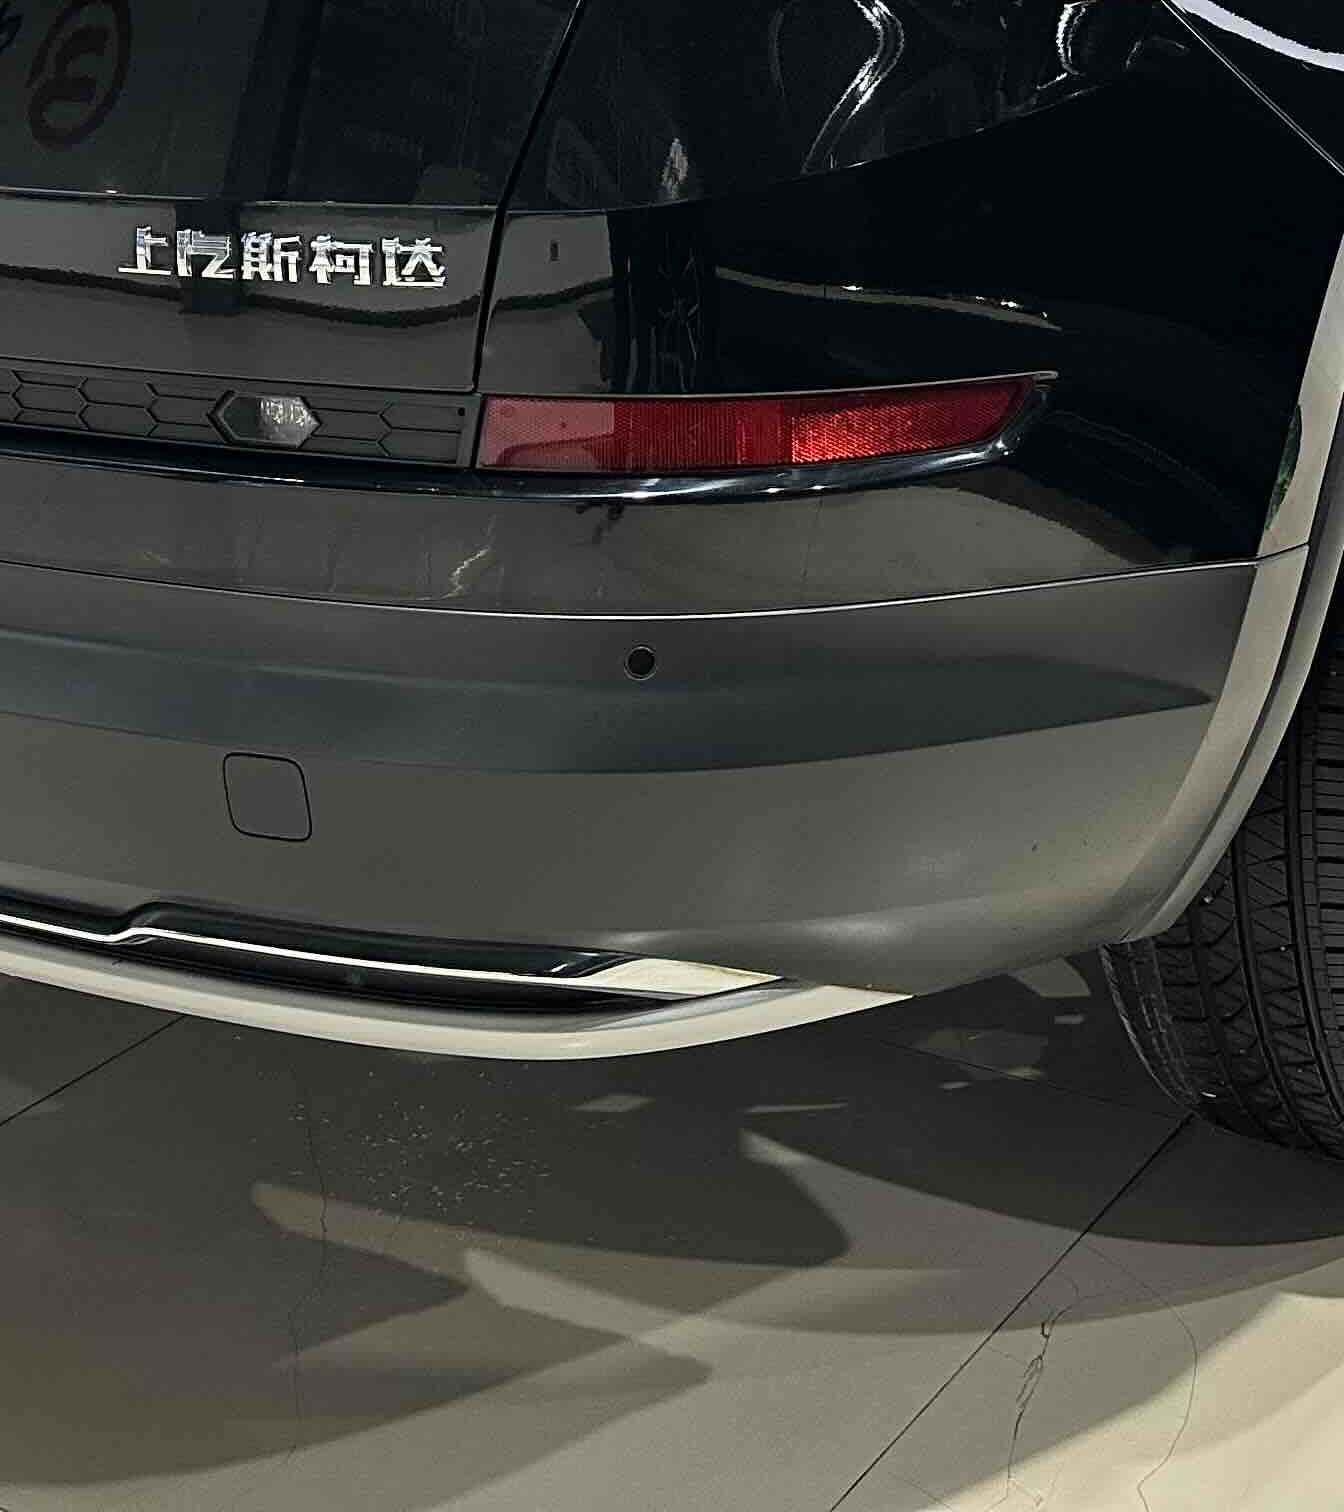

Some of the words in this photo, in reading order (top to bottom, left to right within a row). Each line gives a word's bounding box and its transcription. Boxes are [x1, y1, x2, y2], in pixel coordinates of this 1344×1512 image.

[118, 223, 447, 288] 上汽斯柯达
